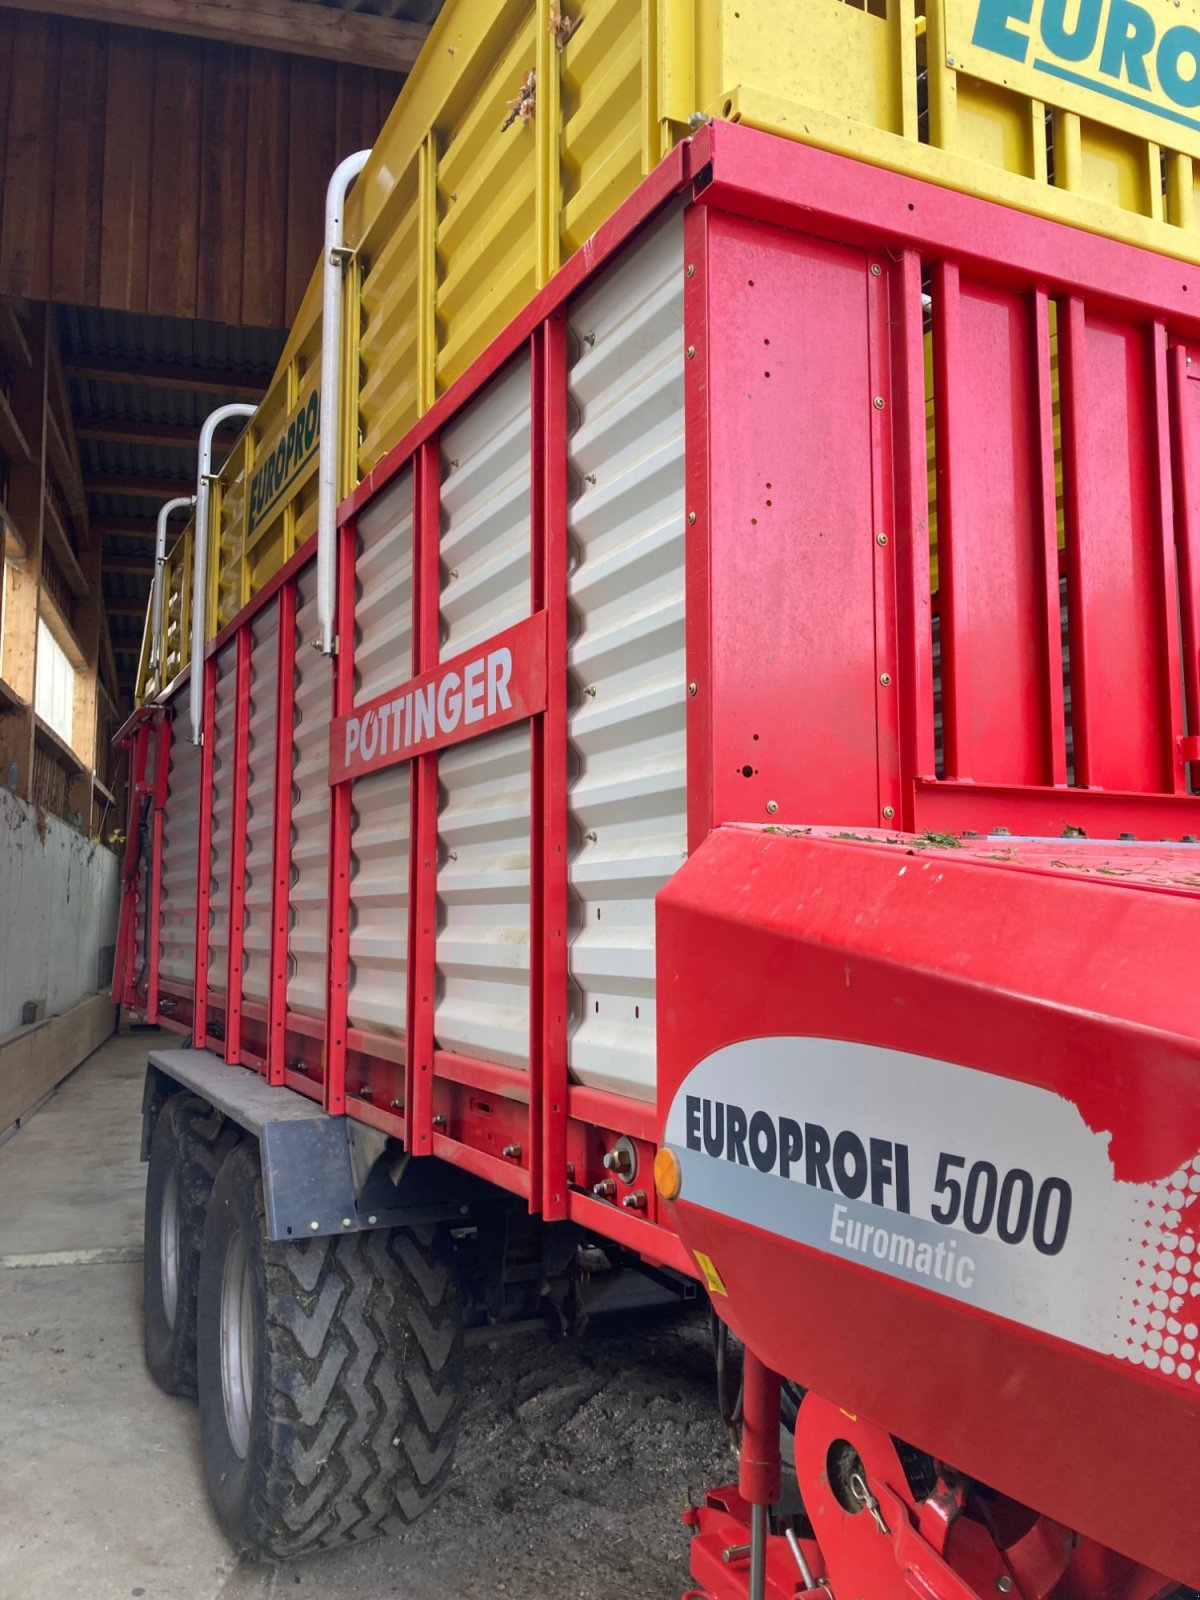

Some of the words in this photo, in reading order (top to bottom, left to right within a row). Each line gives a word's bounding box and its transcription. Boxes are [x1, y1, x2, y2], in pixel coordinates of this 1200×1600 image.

[248, 389, 321, 536] EUROPRO
[345, 647, 512, 768] PÖTTINGER
[686, 1095, 910, 1214] EUROPROFI
[931, 1152, 1072, 1256] 5000
[829, 1204, 976, 1289] Euromatic
